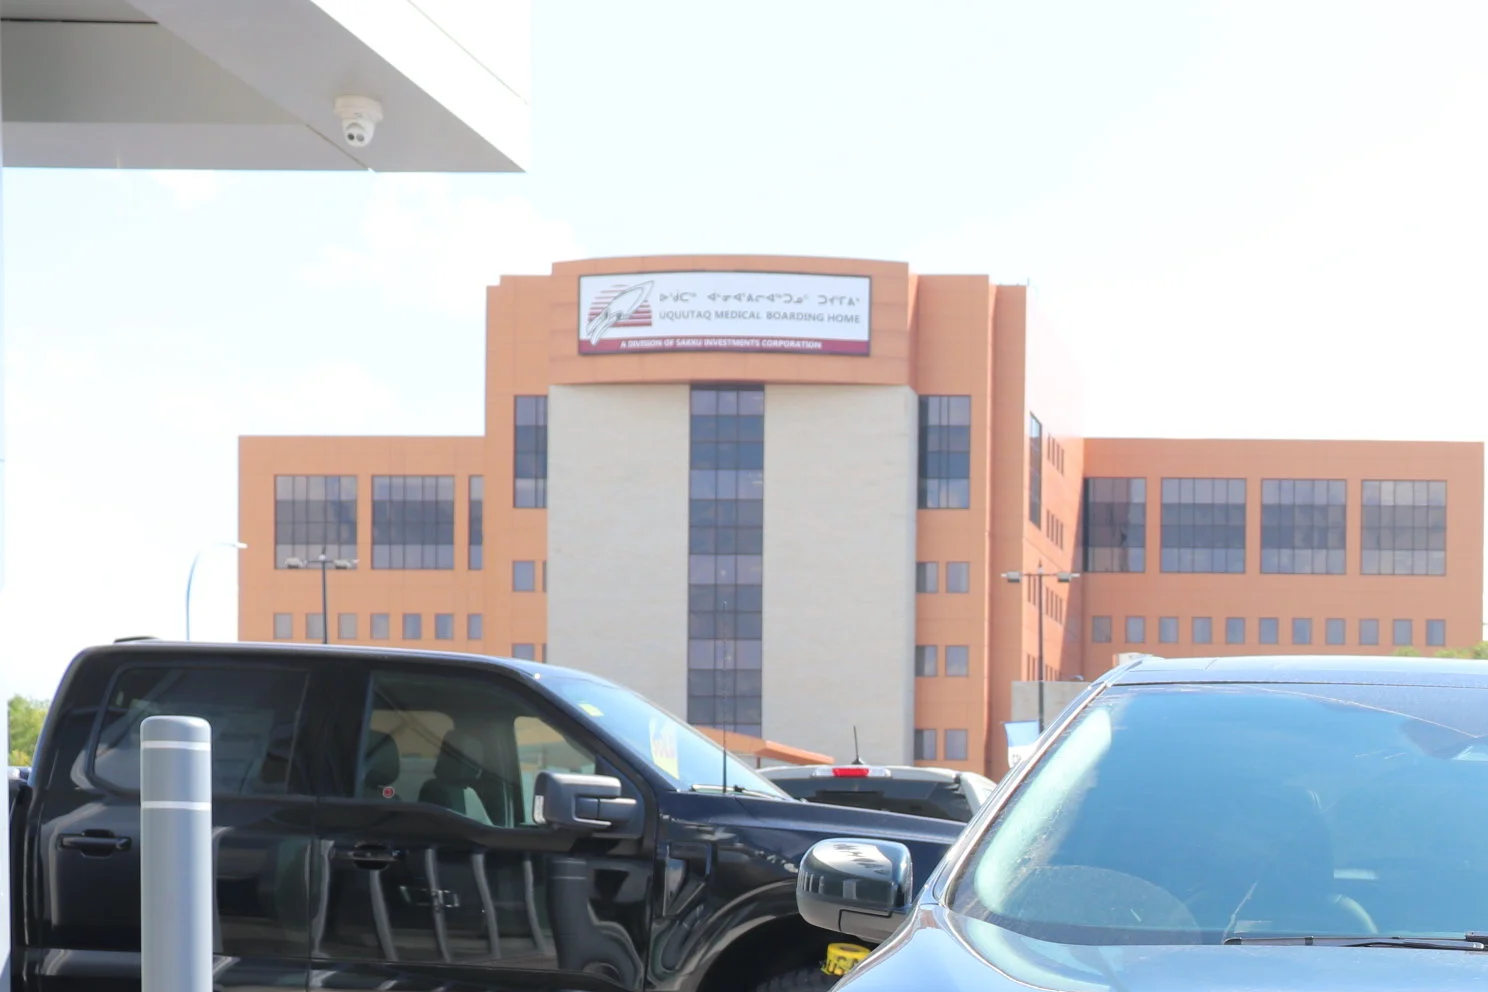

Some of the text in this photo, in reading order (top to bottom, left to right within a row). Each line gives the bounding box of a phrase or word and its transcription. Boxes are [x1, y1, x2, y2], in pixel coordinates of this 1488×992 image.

[659, 310, 861, 323] UQUUTAQ MEDICAL BOARDING HOME
[620, 340, 627, 348] A
[627, 339, 662, 347] DIVISION
[664, 339, 675, 347] OF
[704, 338, 760, 347] INVESTMENTS
[761, 339, 822, 349] CORPORATION
